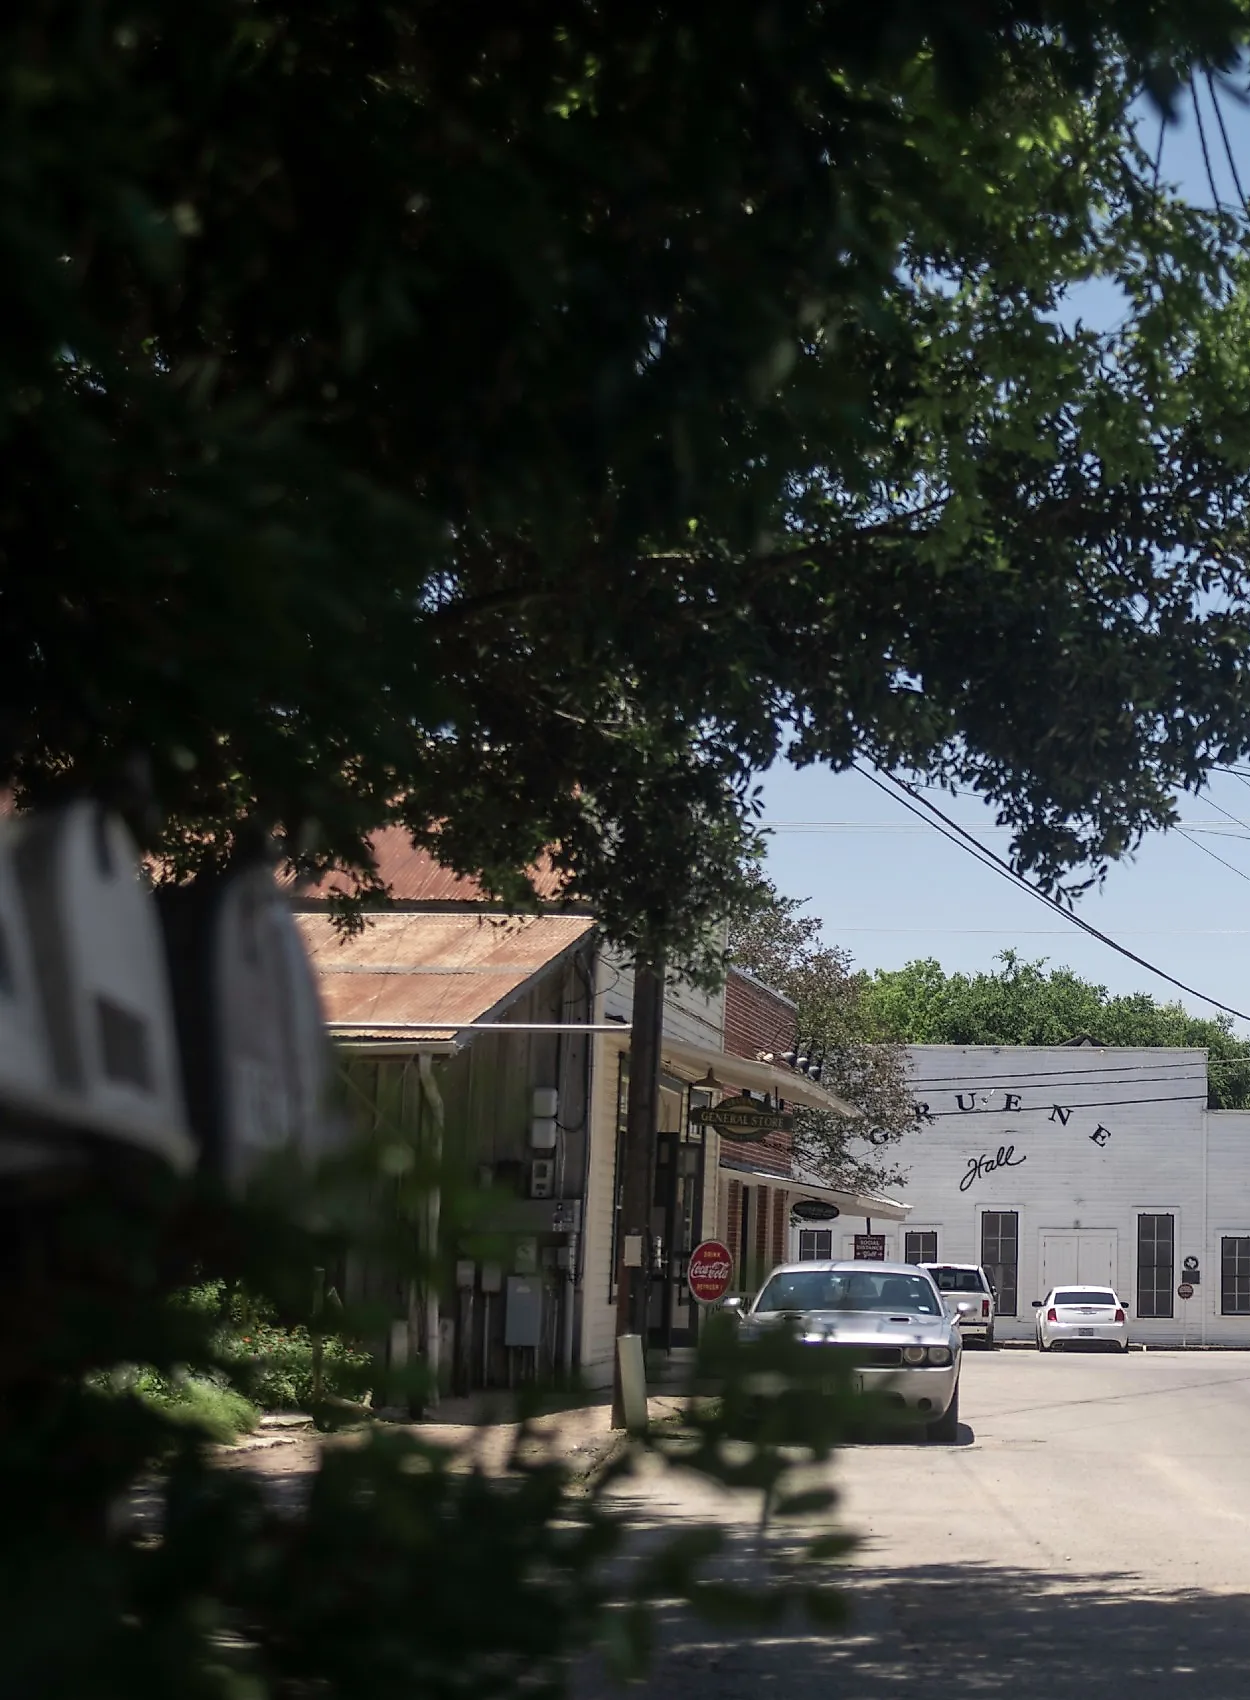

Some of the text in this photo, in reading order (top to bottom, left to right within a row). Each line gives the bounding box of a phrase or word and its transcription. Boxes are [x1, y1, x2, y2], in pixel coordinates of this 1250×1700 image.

[701, 1111, 784, 1128] GENERAL STORE
[959, 1145, 1027, 1191] Hall
[690, 1260, 730, 1279] Coca-Cola
